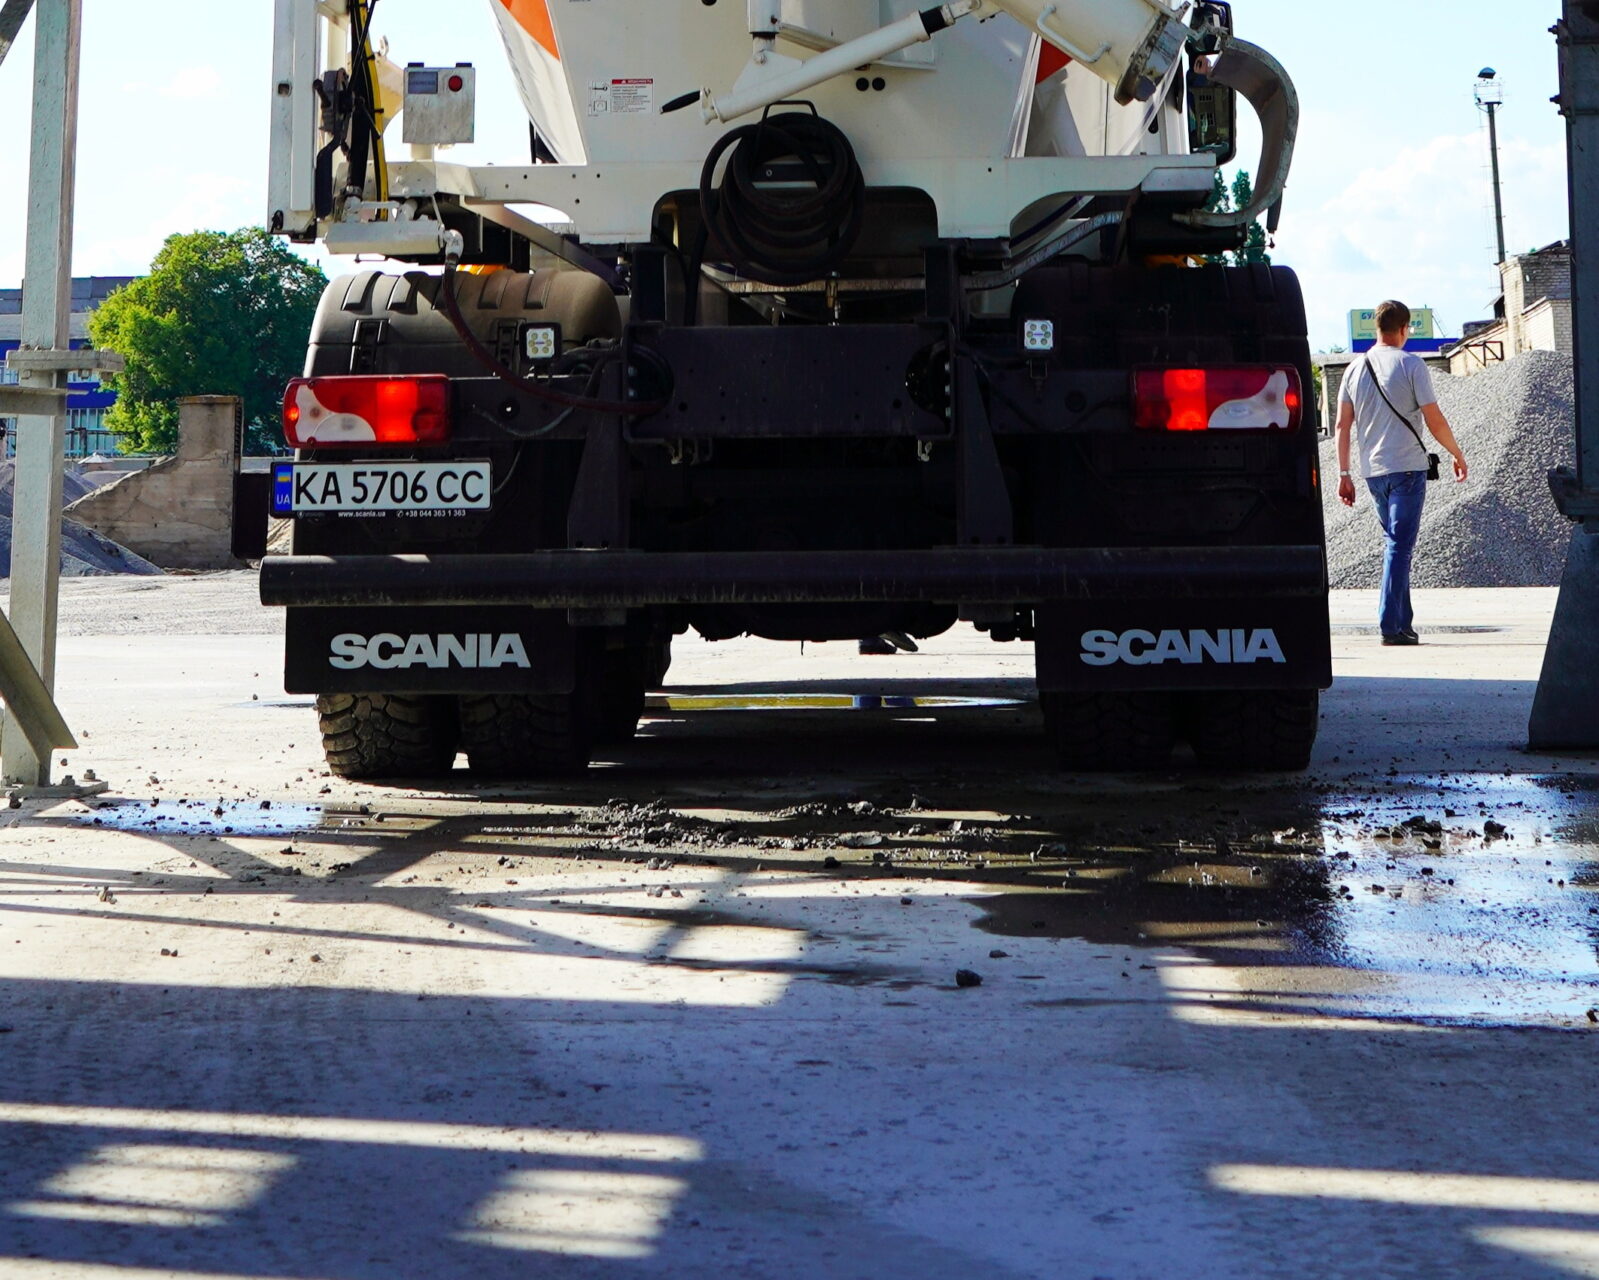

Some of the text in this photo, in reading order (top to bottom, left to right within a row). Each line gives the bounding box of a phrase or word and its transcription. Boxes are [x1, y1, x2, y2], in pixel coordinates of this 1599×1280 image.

[276, 493, 291, 505] UA
[295, 470, 484, 505] KA 5706 CC
[337, 510, 386, 518] www.scania.ua
[405, 509, 418, 518] +38
[329, 632, 531, 669] SCANIA
[1080, 628, 1287, 666] SCANIA
